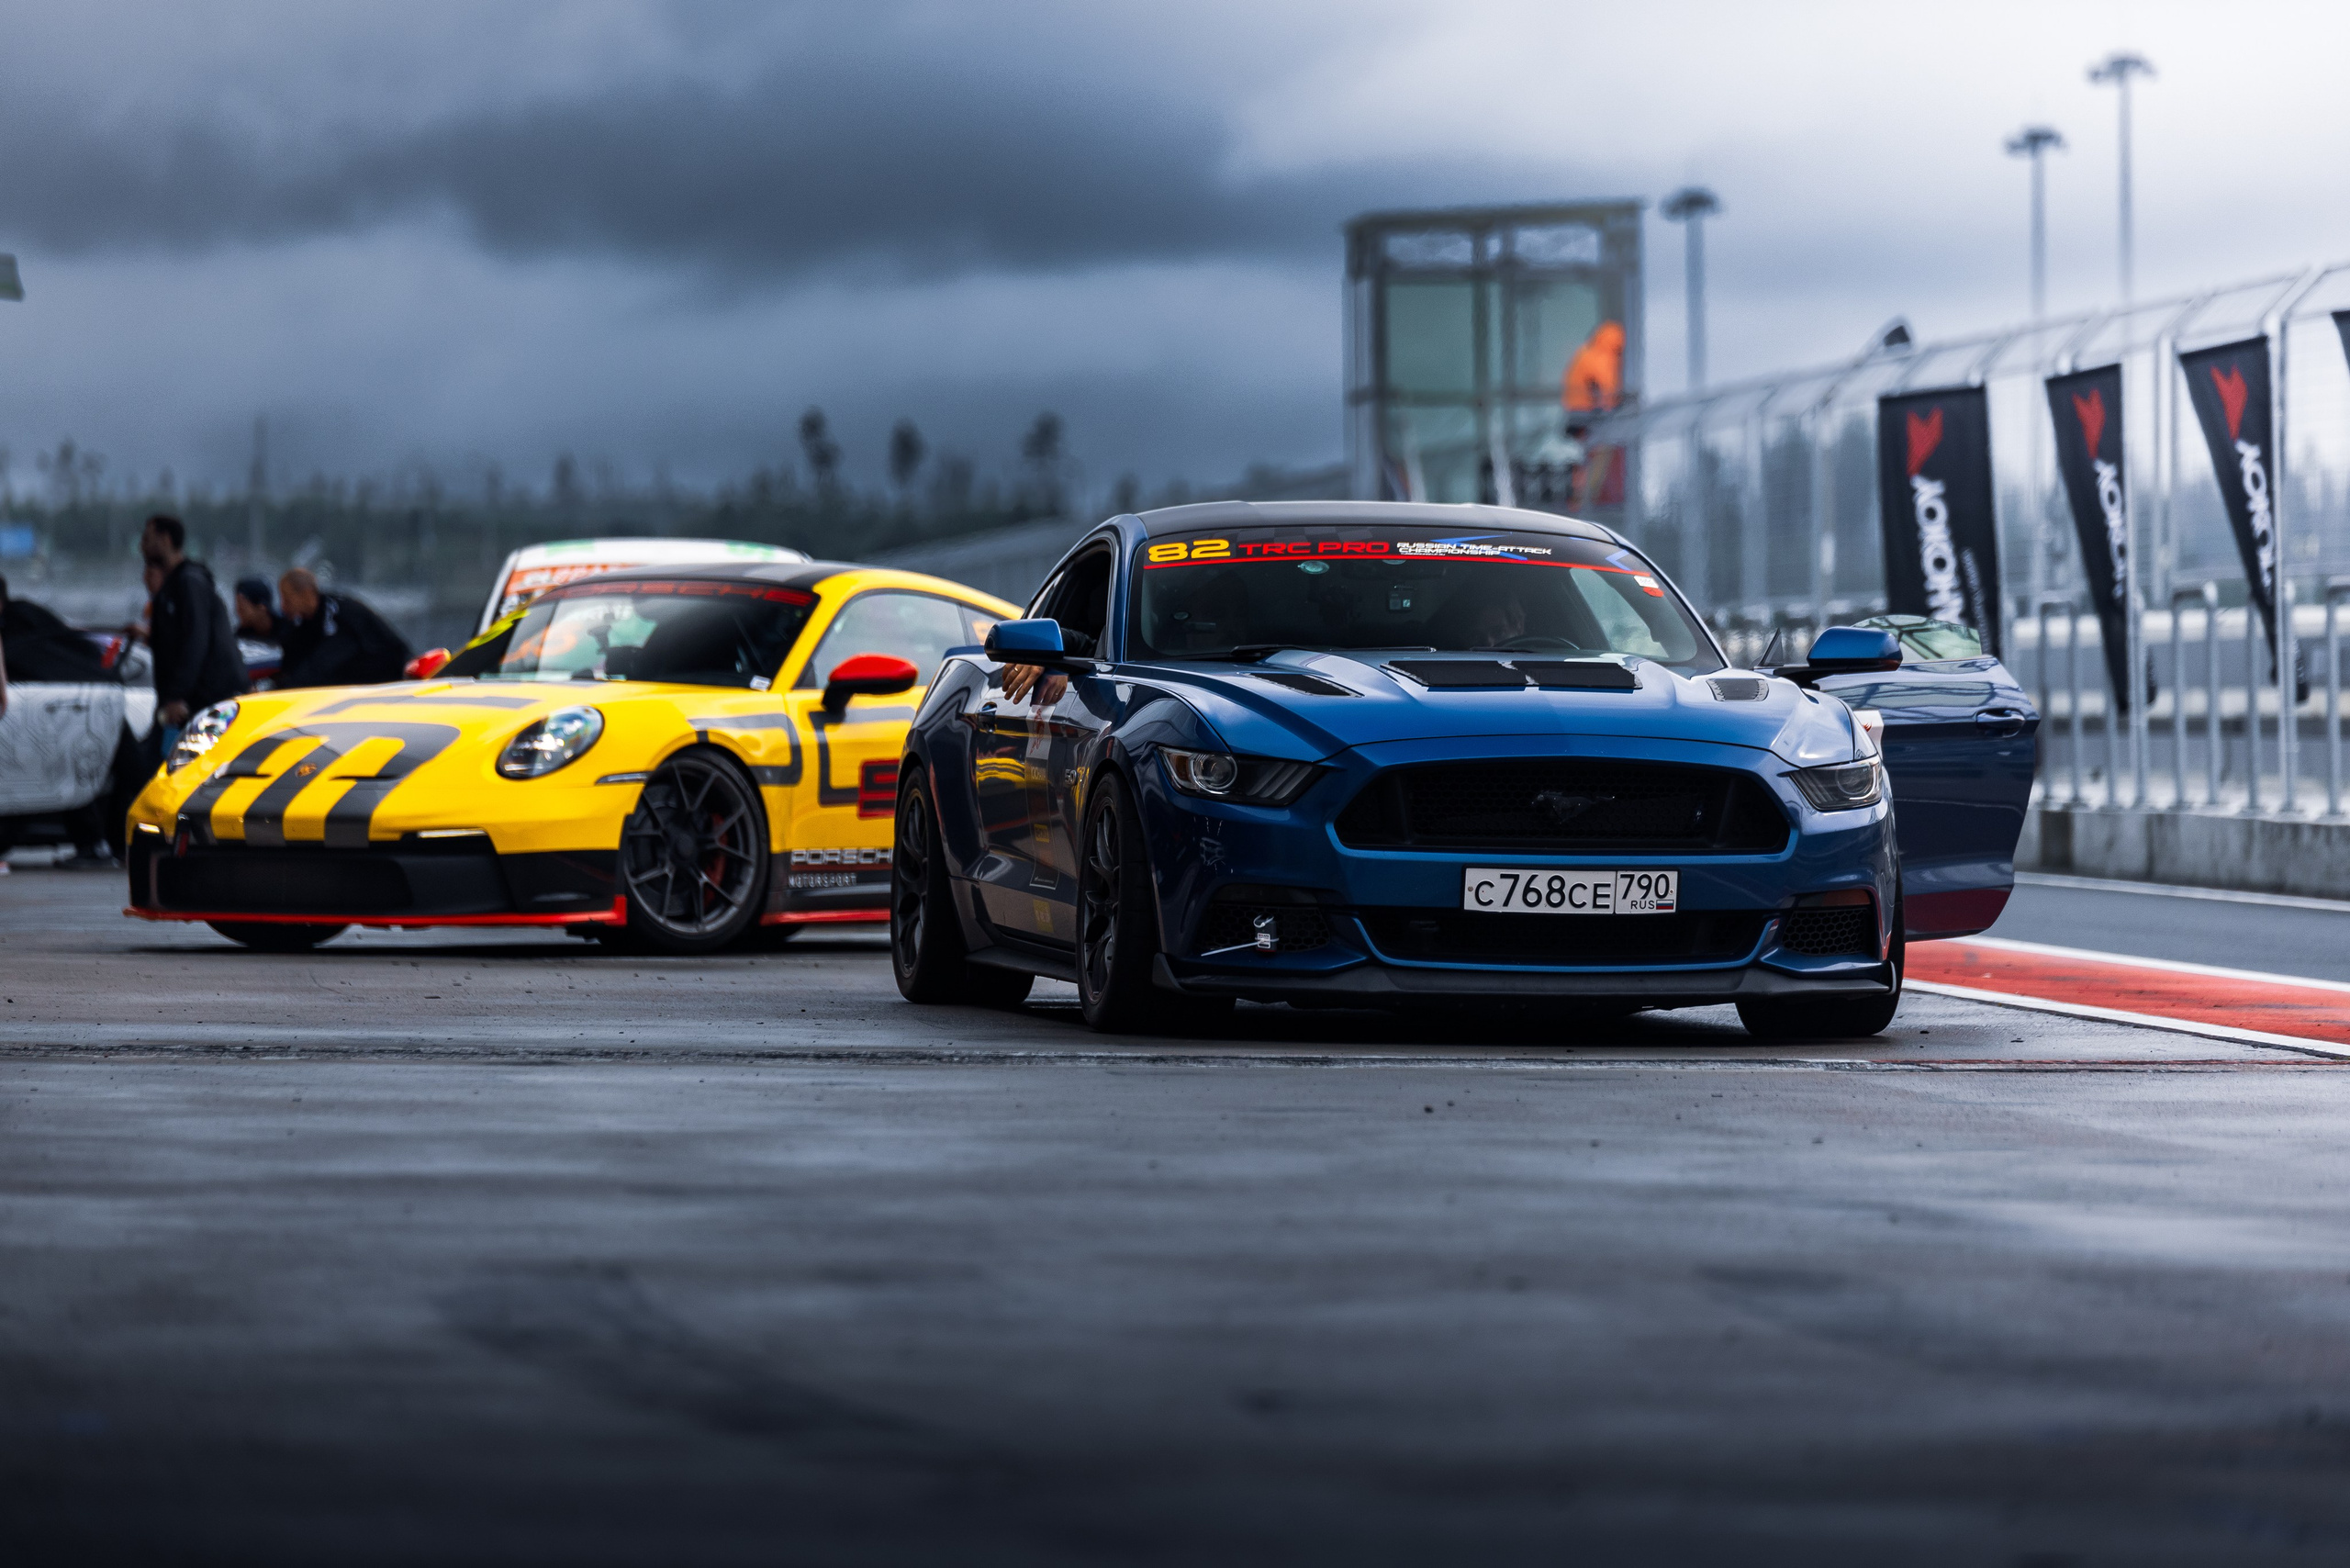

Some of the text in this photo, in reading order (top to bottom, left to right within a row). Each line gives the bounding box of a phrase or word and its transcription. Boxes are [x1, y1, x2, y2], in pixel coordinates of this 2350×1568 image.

[1147, 538, 1390, 563] 82 TRC PRO
[1397, 542, 1457, 551] RUSSIAN
[1398, 545, 1501, 555] CHAMPIONSHIP
[790, 848, 893, 865] PORSCH
[789, 872, 857, 888] MOTORSPORT
[1619, 873, 1671, 900] 790
[1630, 900, 1655, 910] RUS
